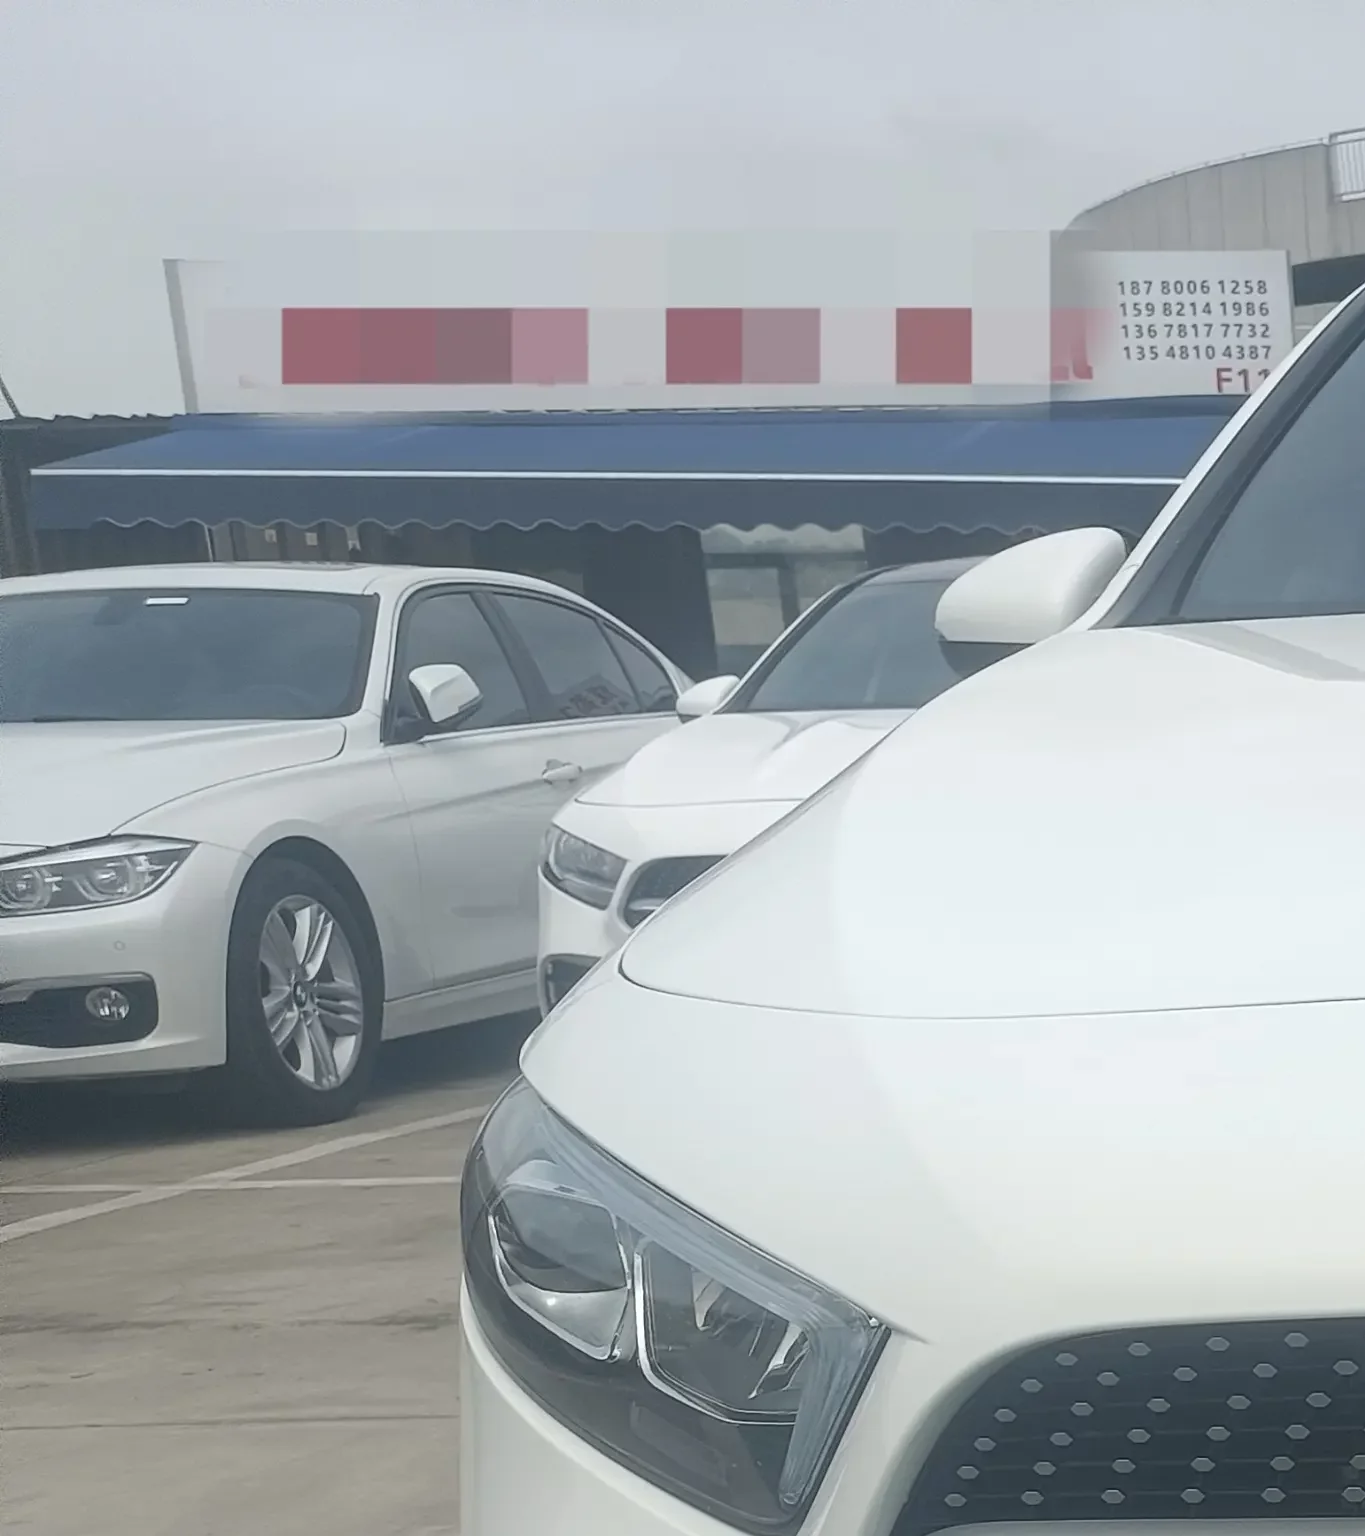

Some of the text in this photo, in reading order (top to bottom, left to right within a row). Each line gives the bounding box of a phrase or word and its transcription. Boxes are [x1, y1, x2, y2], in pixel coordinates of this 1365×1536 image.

[1118, 280, 1268, 295] 187 8006 1258
[1119, 301, 1270, 317] 159 8214 1986
[1121, 323, 1270, 339] 136 7817 7732
[1123, 345, 1271, 360] 135 4810 4387
